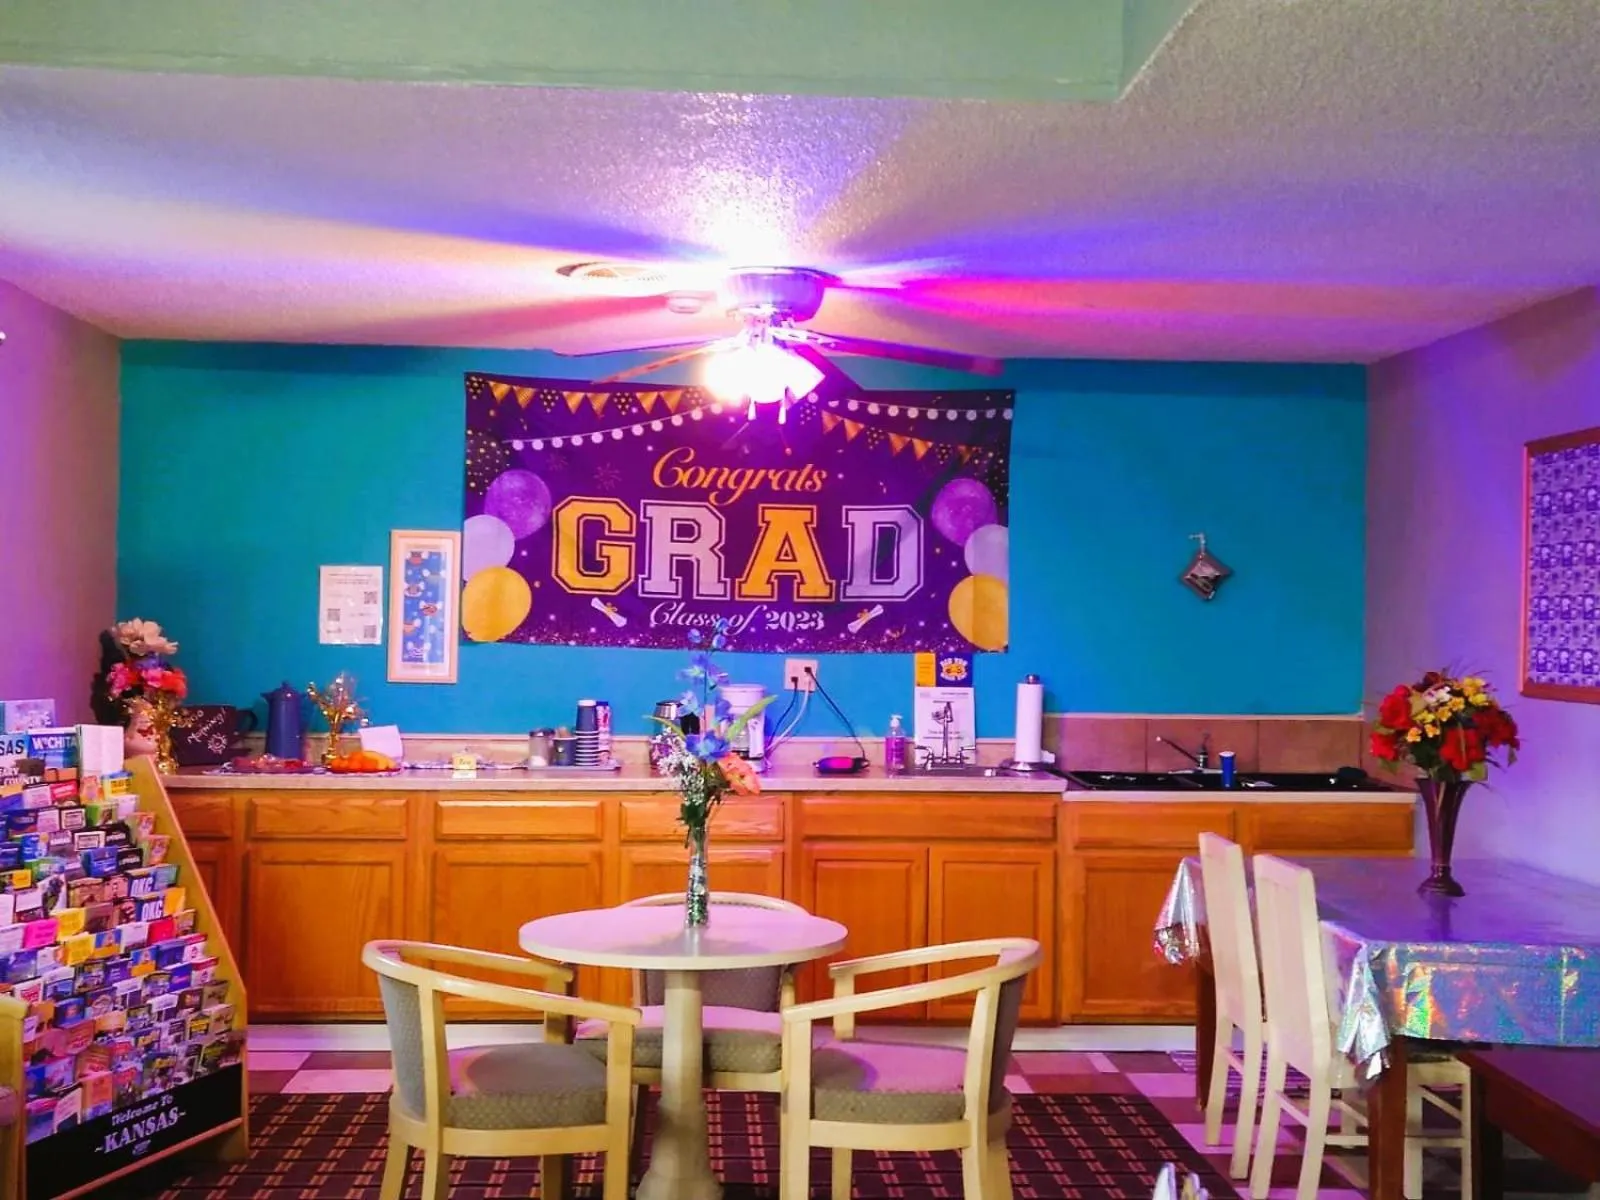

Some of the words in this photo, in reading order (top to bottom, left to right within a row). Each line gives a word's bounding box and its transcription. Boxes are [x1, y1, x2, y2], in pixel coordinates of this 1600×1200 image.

[652, 446, 828, 507] Congrats
[551, 495, 925, 602] GRAD
[649, 601, 721, 628] Class
[722, 603, 768, 637] of
[765, 610, 826, 632] 2023
